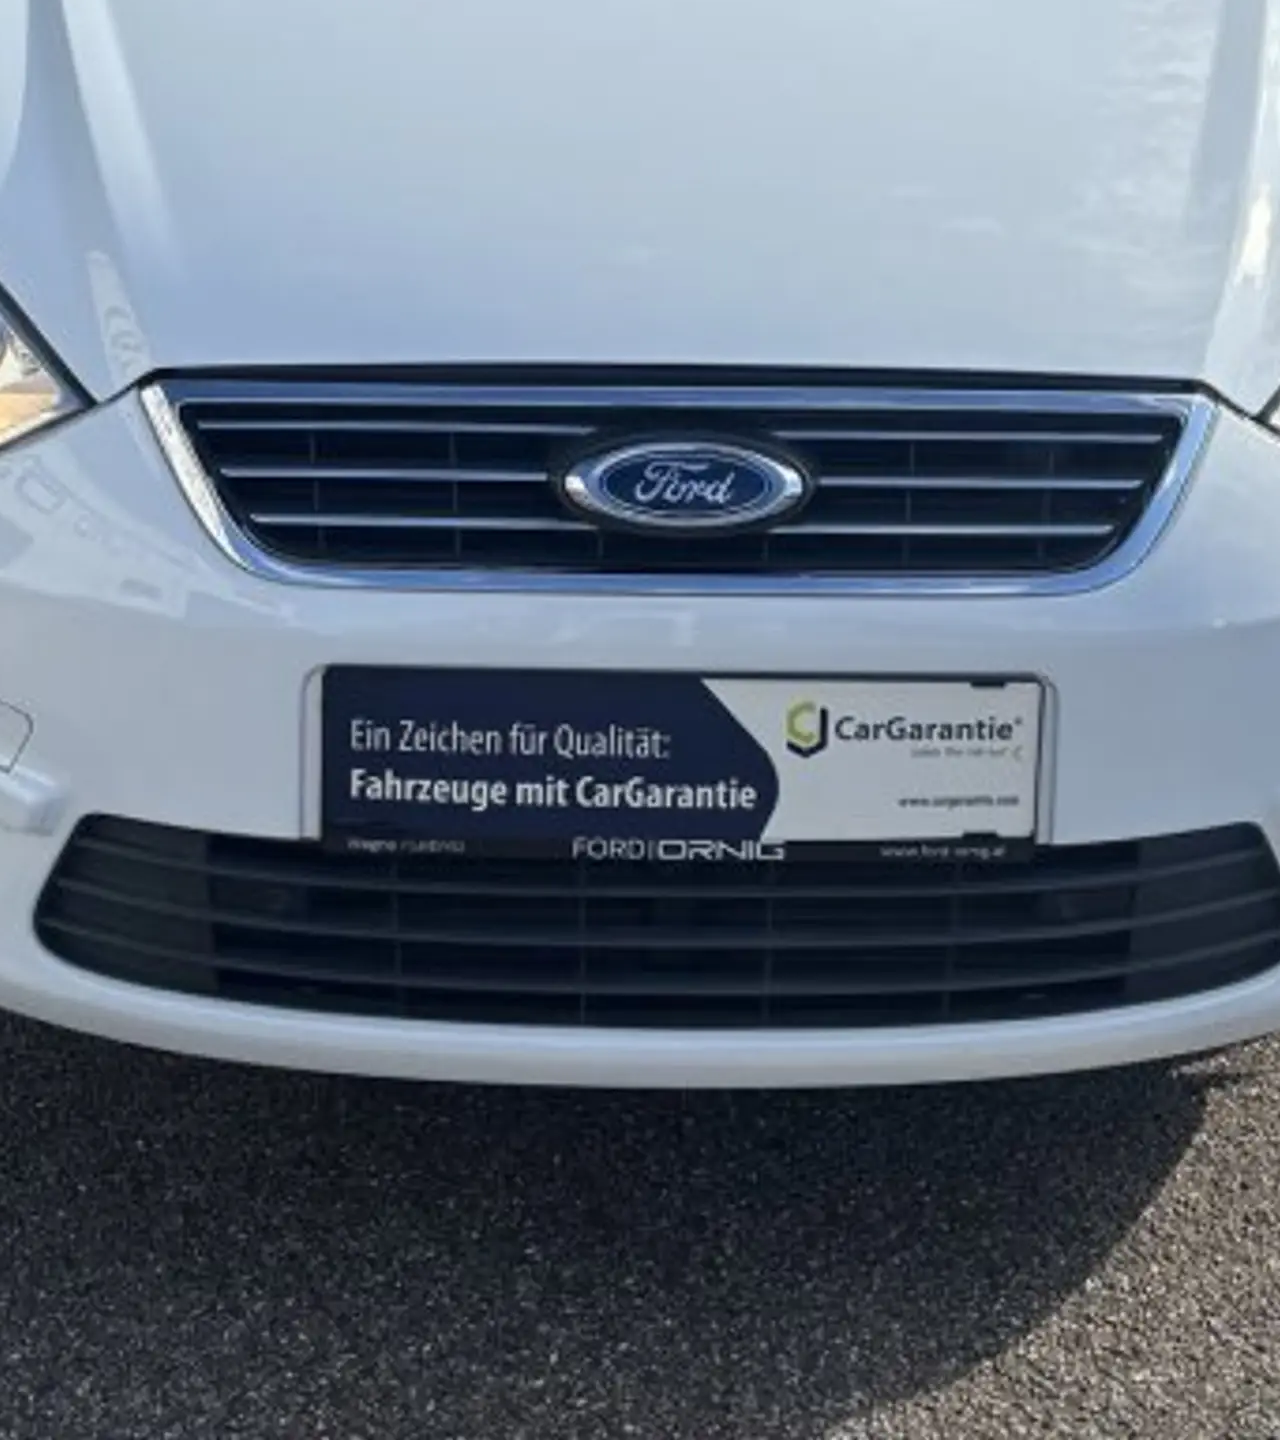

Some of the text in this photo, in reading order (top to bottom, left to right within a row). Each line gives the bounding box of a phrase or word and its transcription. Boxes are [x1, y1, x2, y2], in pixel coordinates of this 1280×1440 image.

[635, 460, 735, 504] Ford
[350, 719, 671, 759] Ein Zeichen für Qualität:
[350, 768, 758, 812] Fahrzeuge mit CarGarantie
[572, 837, 645, 860] FORD
